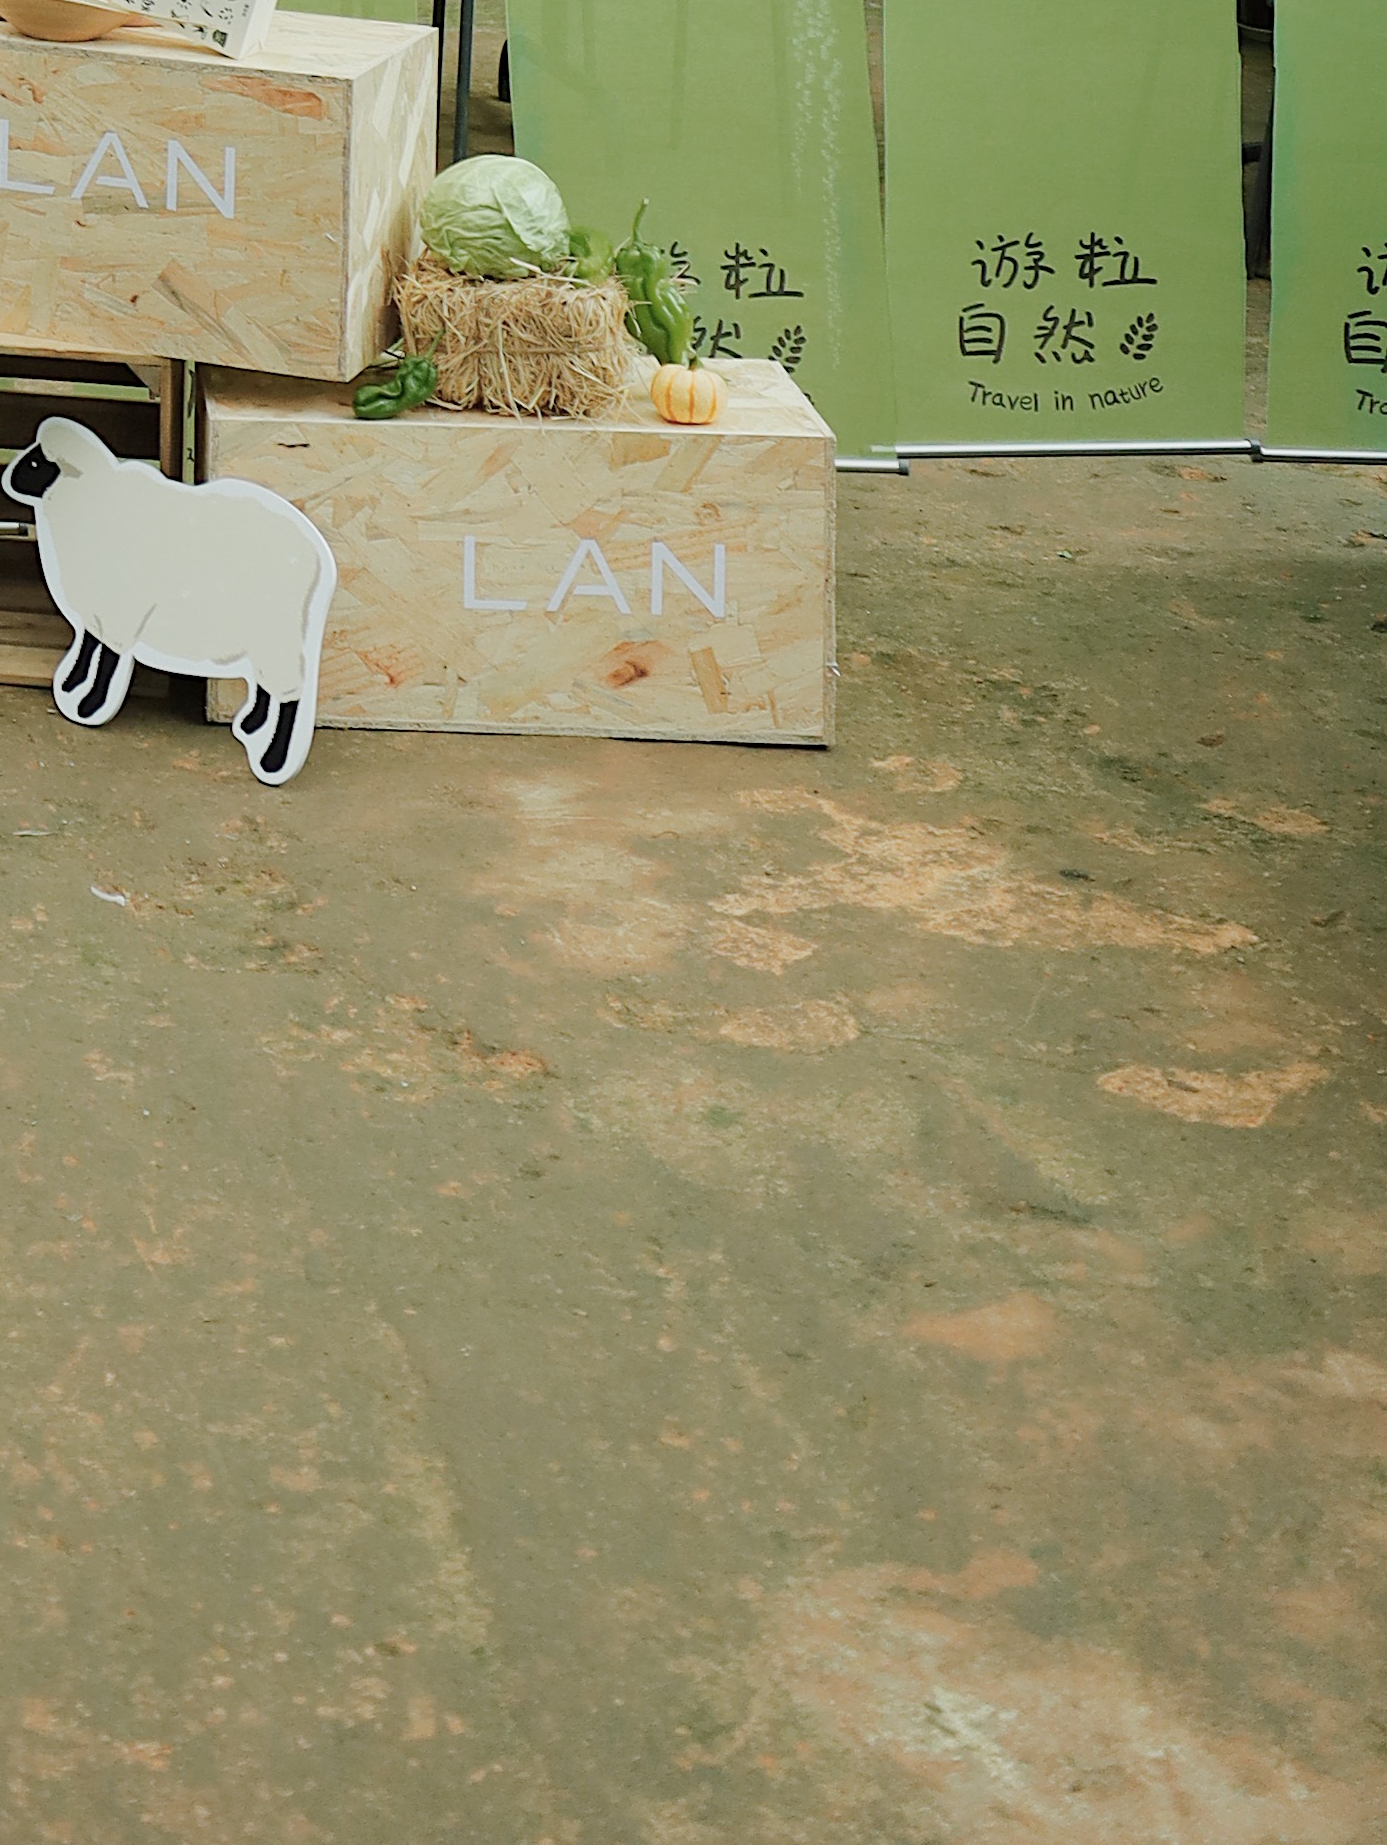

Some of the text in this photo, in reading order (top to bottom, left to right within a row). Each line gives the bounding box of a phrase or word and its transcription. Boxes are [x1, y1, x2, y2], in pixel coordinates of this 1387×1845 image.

[970, 231, 1158, 290] 游粒
[958, 302, 1096, 365] 自然
[968, 375, 1164, 413] Travel in nature
[462, 534, 727, 619] LAN
